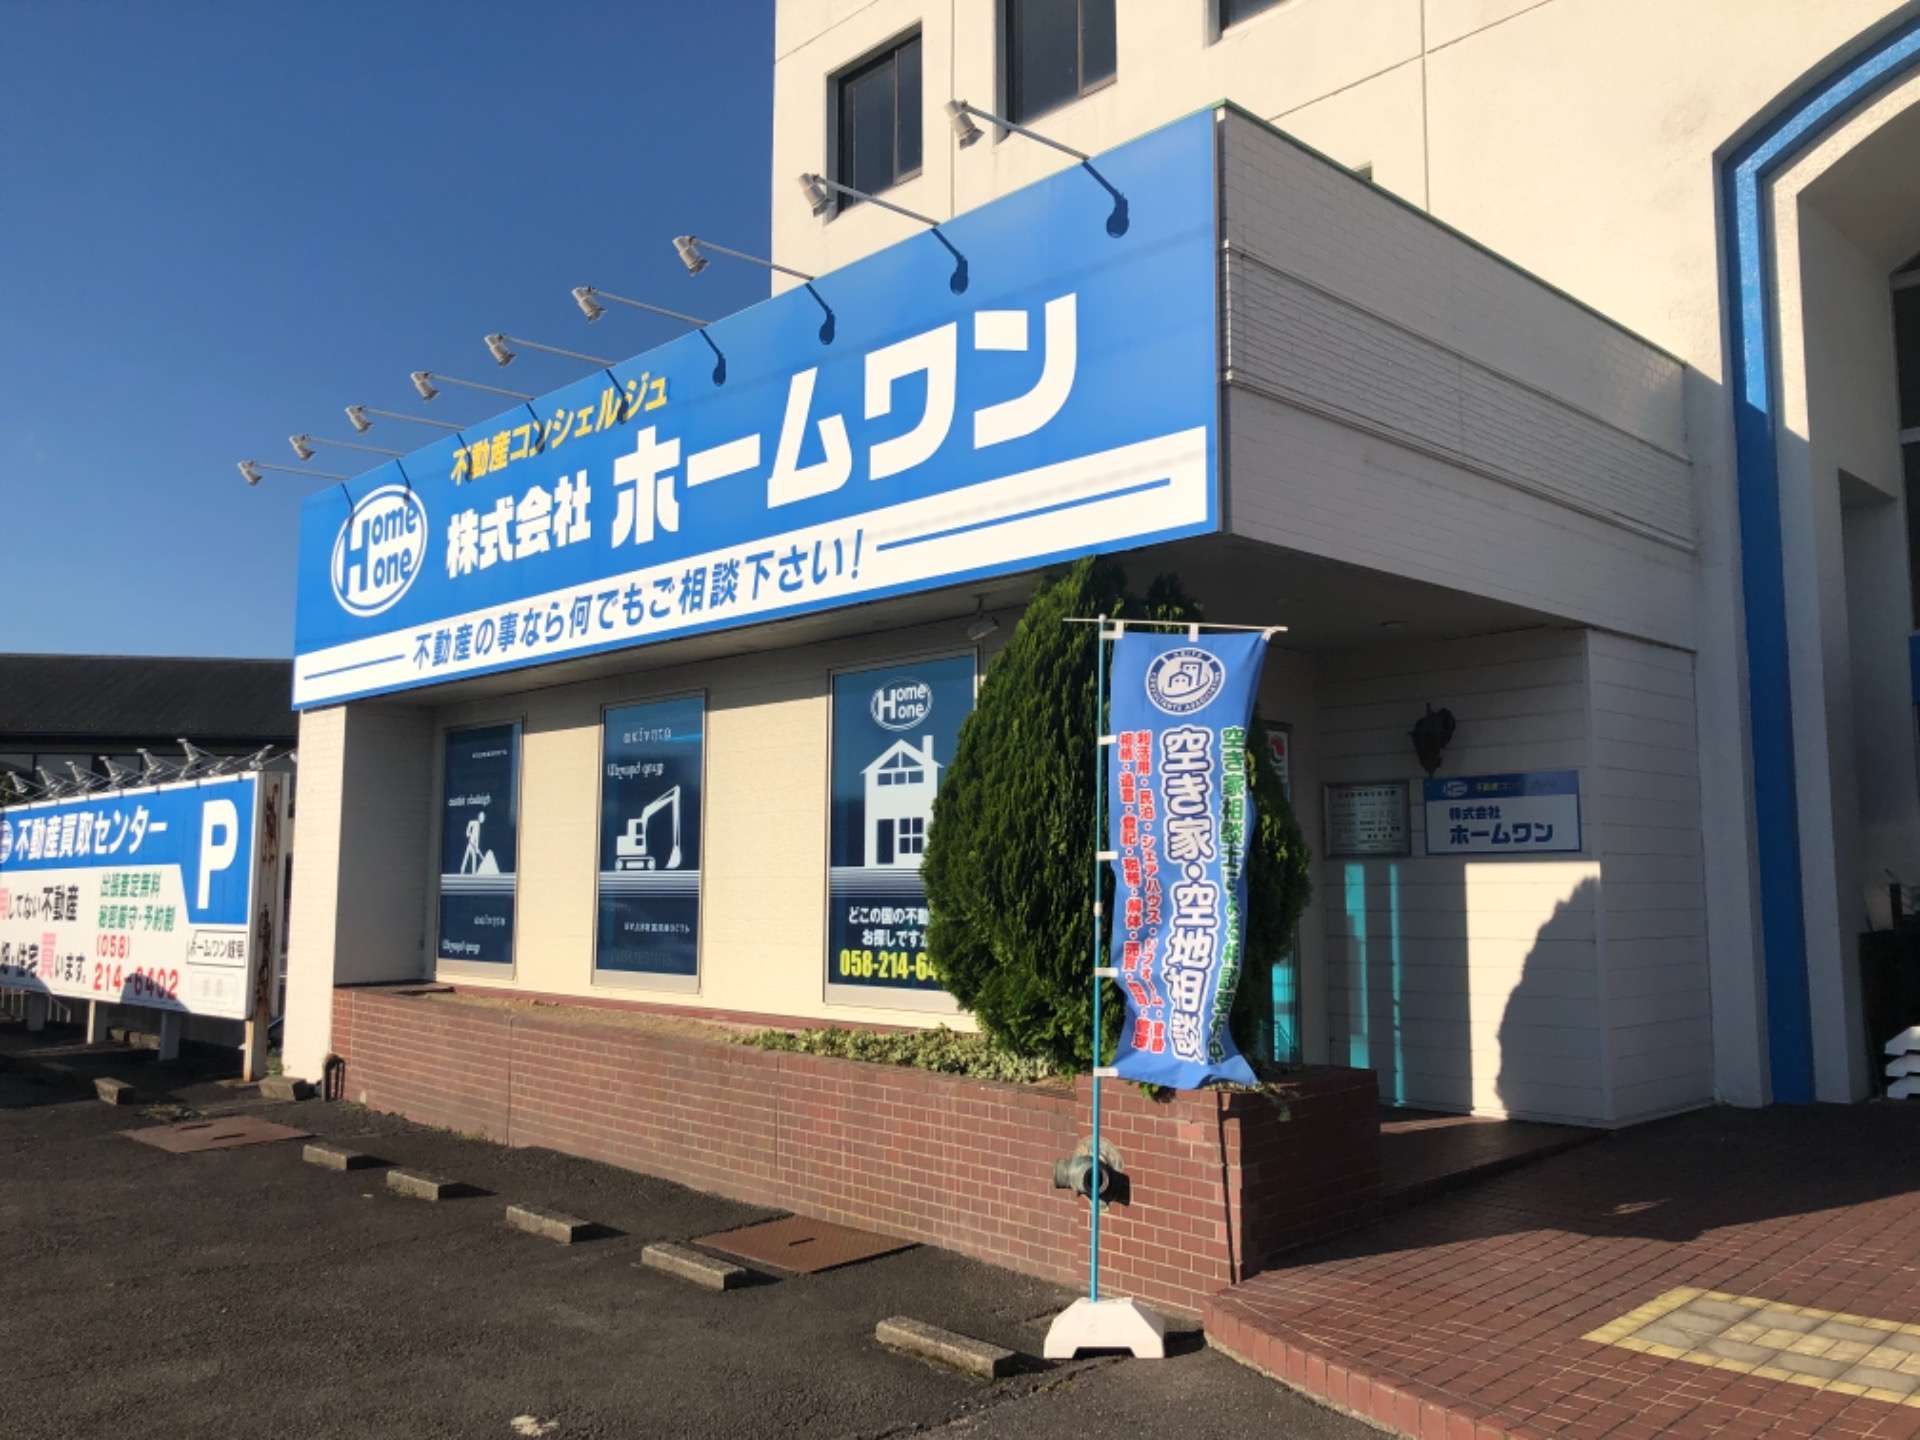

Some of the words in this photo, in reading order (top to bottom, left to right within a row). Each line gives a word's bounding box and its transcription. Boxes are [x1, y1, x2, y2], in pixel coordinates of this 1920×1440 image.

[450, 371, 668, 487] 不動産コンシェルジュ
[611, 292, 1077, 548] ホームワン
[341, 506, 418, 600] Home
[445, 469, 592, 580] 株式会社
[15, 805, 168, 860] 不動産買取センター
[197, 799, 239, 909] P
[1449, 805, 1501, 820] 株式会社
[1450, 822, 1553, 845] ホームワン
[1159, 724, 1218, 1064] 空き家・空地相談
